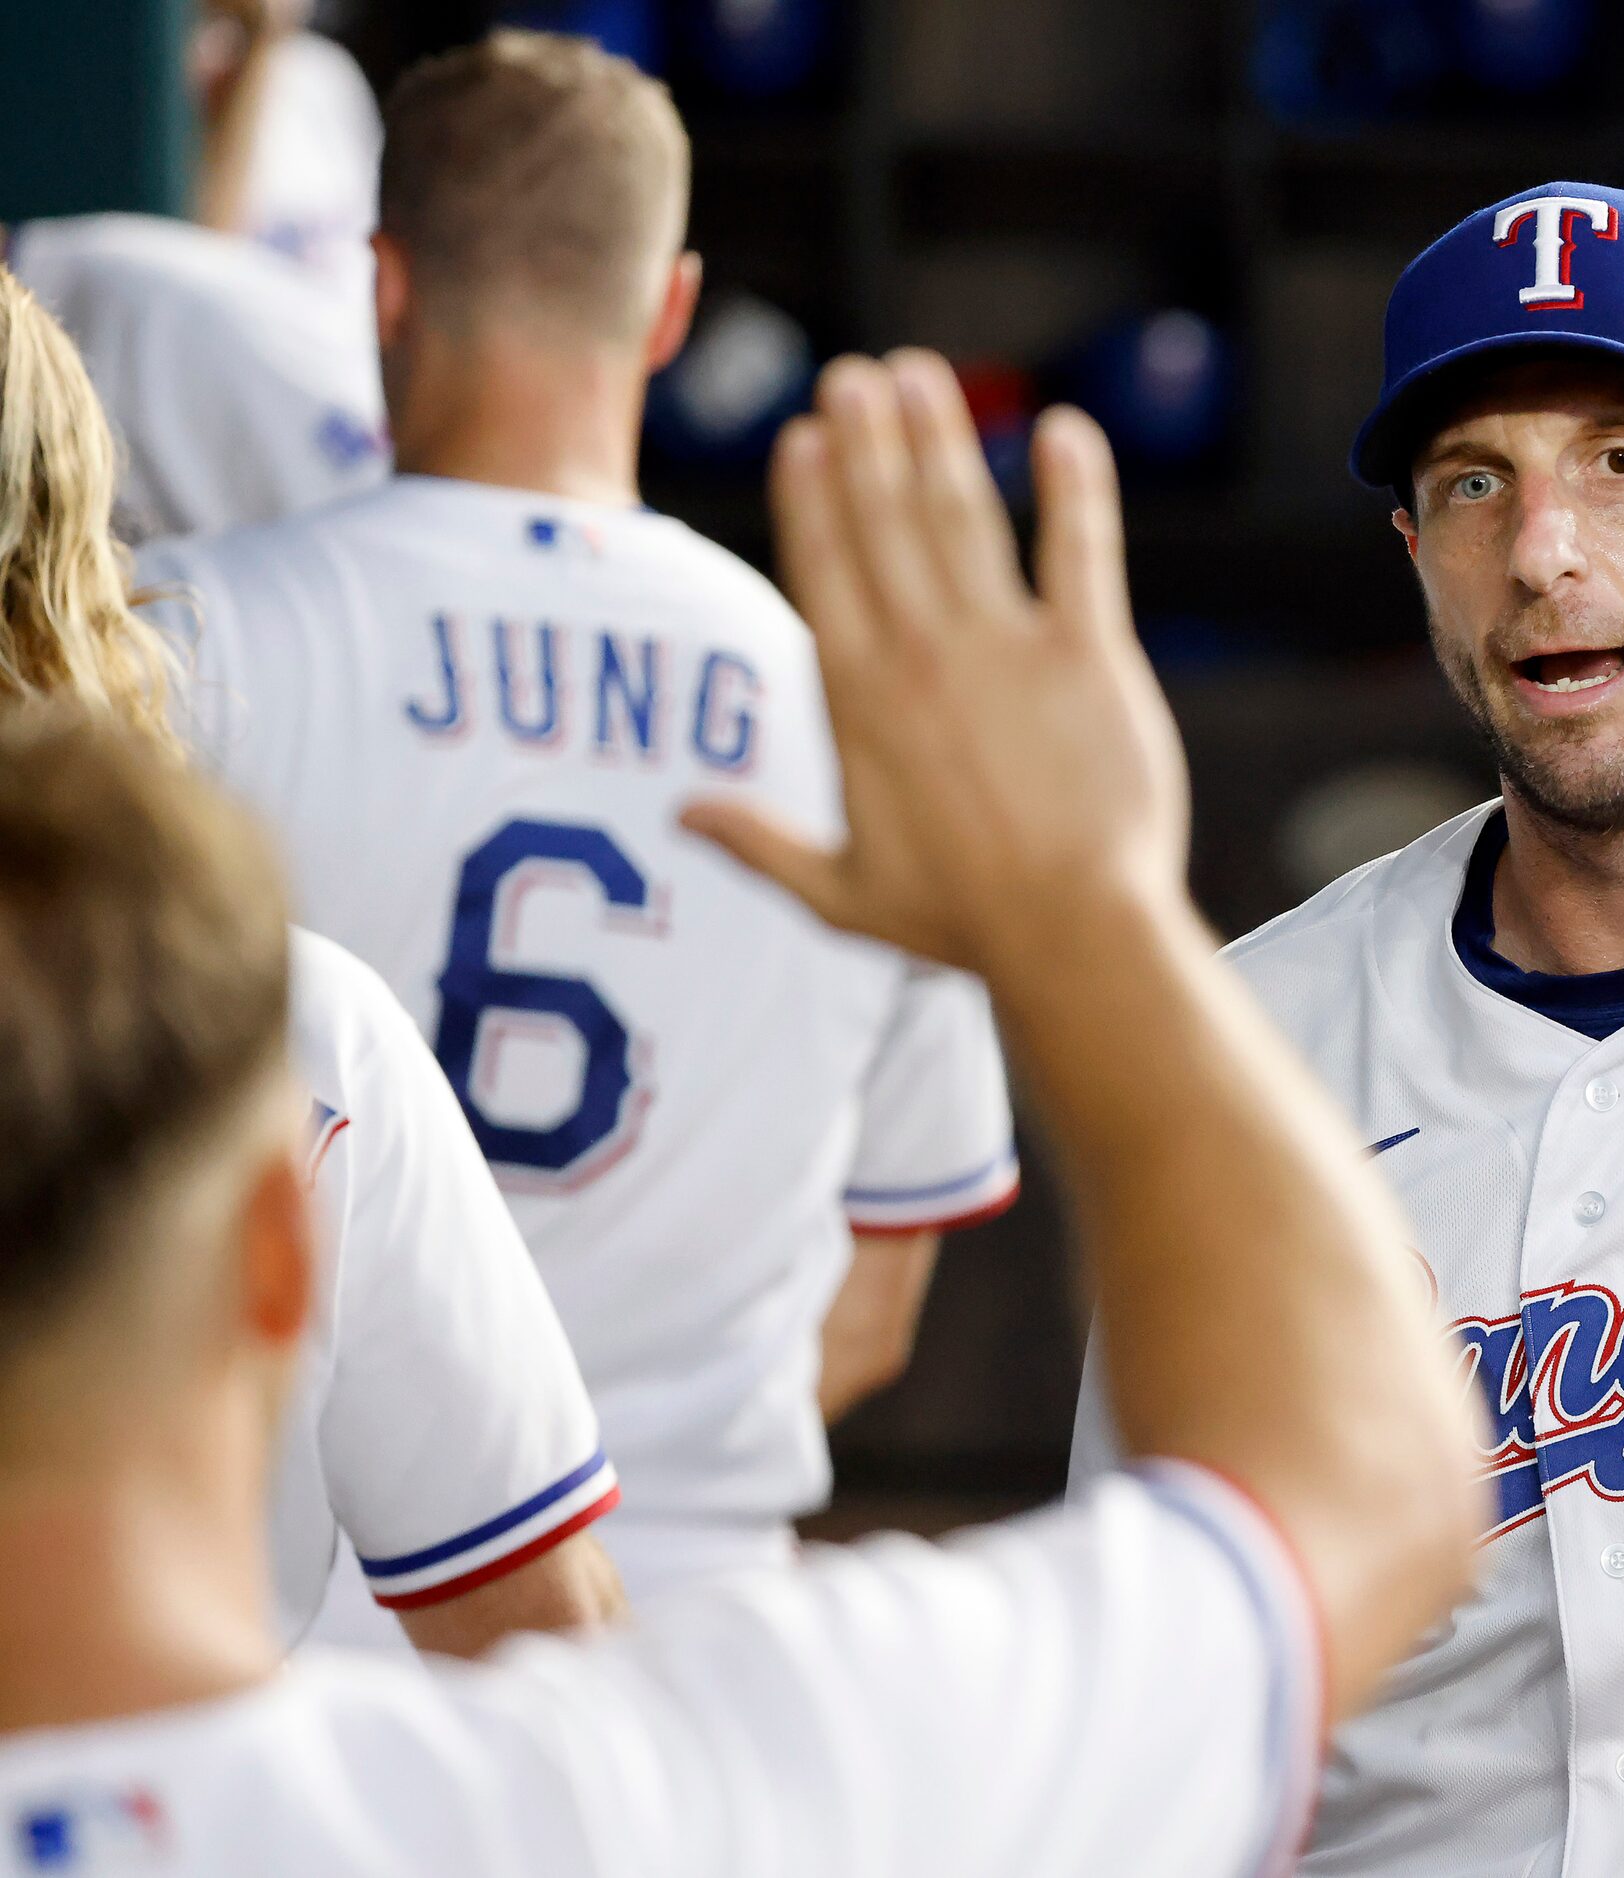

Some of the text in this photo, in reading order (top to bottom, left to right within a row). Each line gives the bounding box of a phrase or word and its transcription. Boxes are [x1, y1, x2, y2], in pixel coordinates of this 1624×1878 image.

[1492, 196, 1619, 311] T
[405, 610, 767, 777] JUNG
[436, 818, 671, 1191] 6
